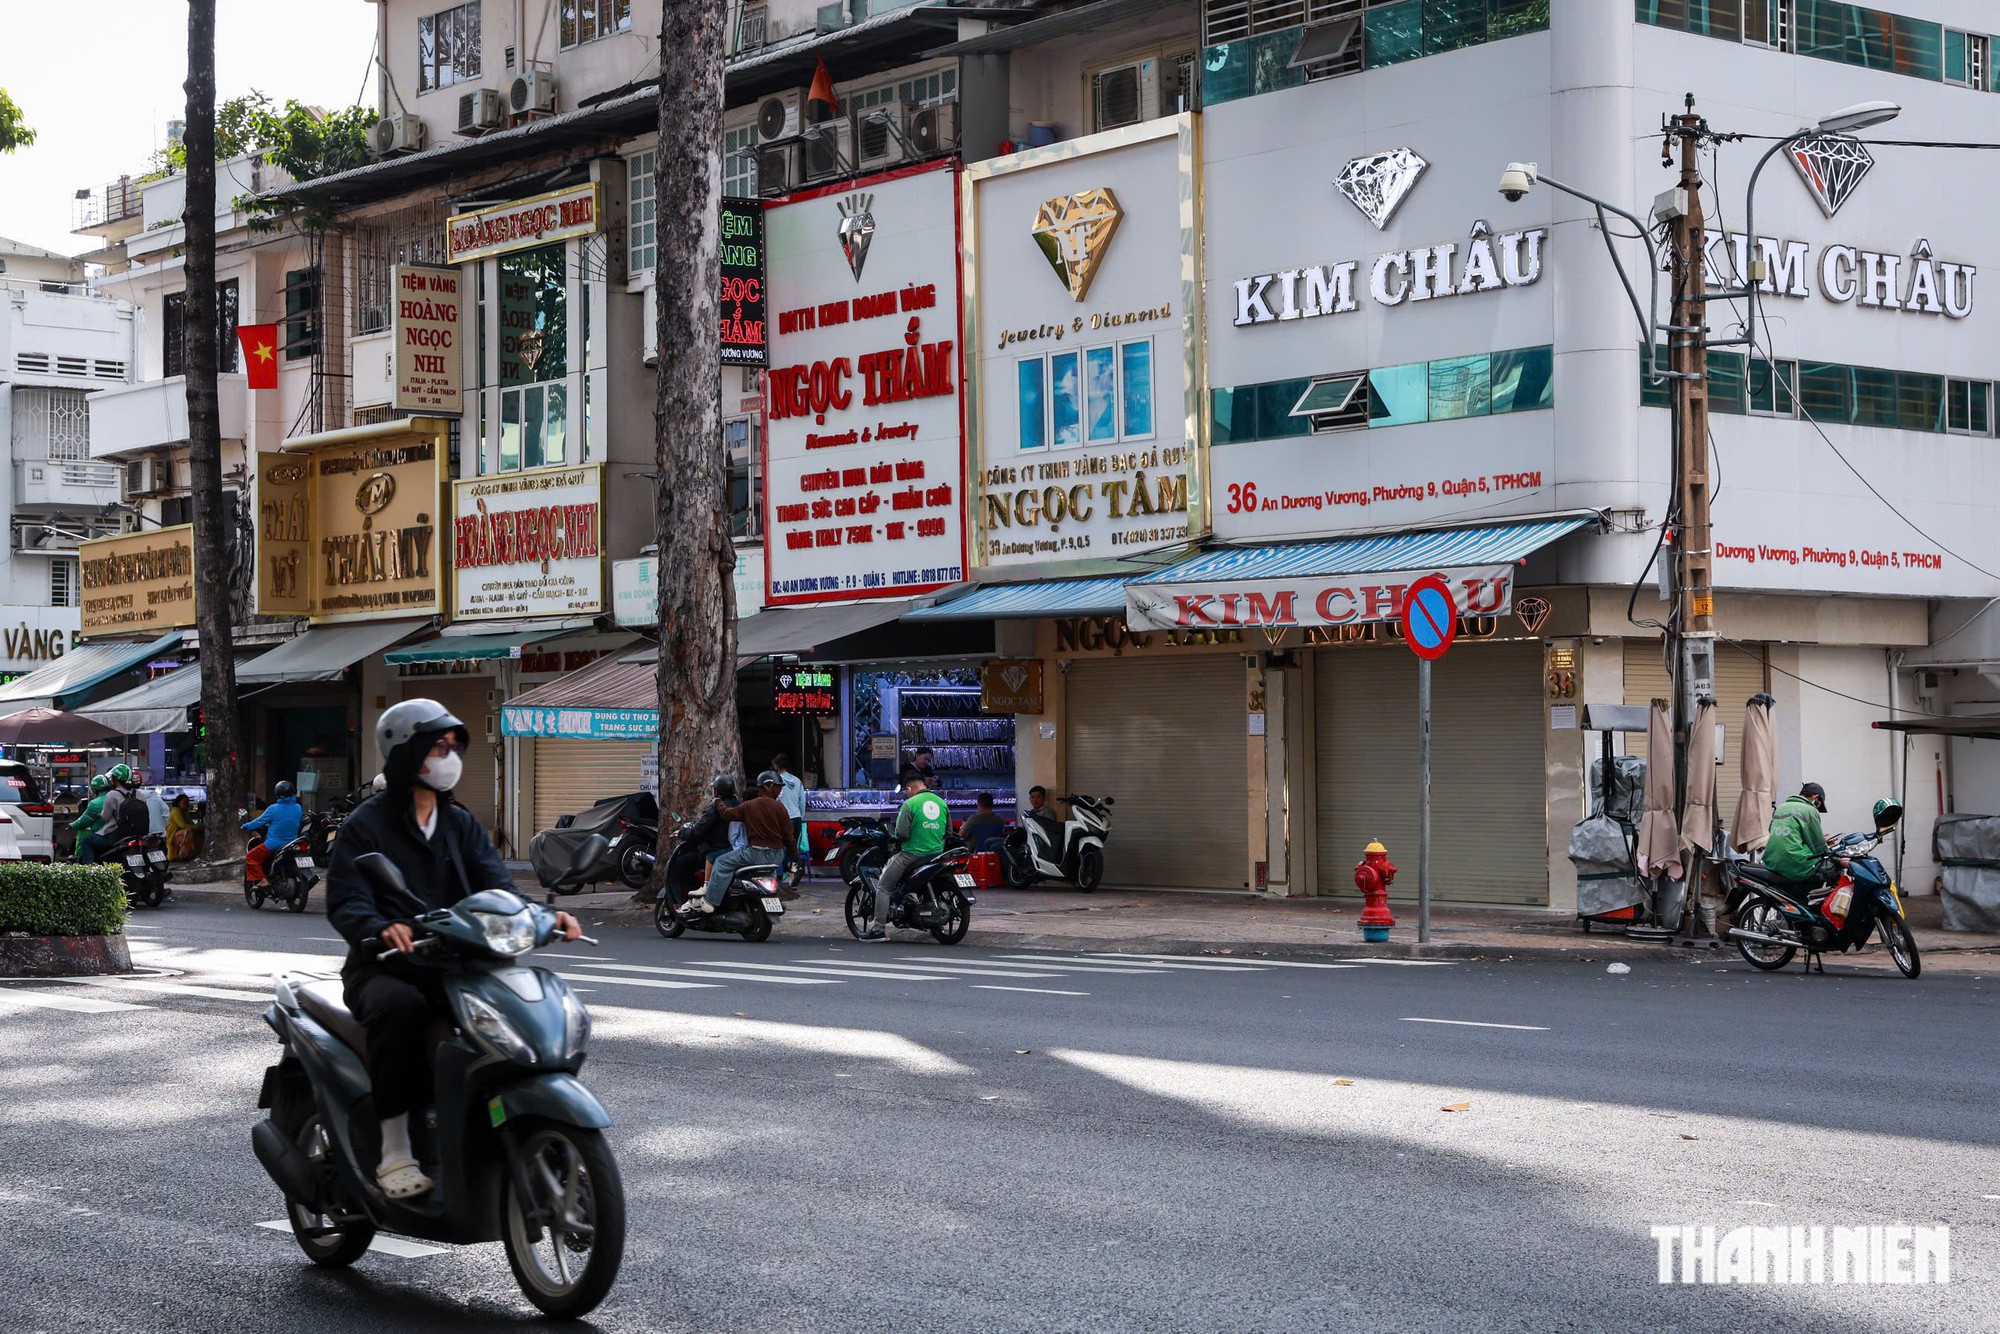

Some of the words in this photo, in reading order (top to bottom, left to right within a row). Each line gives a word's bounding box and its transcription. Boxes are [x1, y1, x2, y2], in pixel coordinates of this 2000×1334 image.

[450, 215, 507, 252] HOÀNG
[509, 204, 557, 239] NGỌC
[559, 197, 593, 228] NHI
[722, 211, 752, 238] ỆM
[721, 241, 756, 266] ÀNG
[401, 273, 426, 293] TIỆM
[430, 275, 456, 293] VÀNG
[1233, 260, 1359, 327] KIM
[1369, 219, 1548, 306] CHÂU
[1701, 227, 1809, 299] KIM
[1816, 238, 1977, 319] CHÂU
[721, 277, 760, 306] GỌC
[400, 298, 457, 322] HOÀNG
[779, 306, 815, 335] DNTN
[818, 300, 849, 327] KINH
[852, 291, 897, 321] DOANH
[900, 283, 936, 312] VÀNG
[406, 328, 452, 351] NGỌC
[998, 324, 1064, 350] Jewelry
[1071, 316, 1083, 333] &
[1091, 302, 1171, 330] Diamond
[414, 354, 445, 374] NHI
[410, 377, 426, 385] ITALIA
[431, 378, 449, 386] PLATIN
[768, 357, 852, 425] NGỌC
[805, 429, 858, 450] Diamonds
[861, 427, 872, 442] &
[874, 422, 919, 441] Jewelry
[842, 468, 867, 487] MUA
[870, 461, 893, 484] BÁN
[895, 458, 925, 481] VÀNG
[987, 464, 1016, 486] CÔNG
[1020, 464, 1034, 481] TY
[1039, 460, 1069, 480] TNHH
[1074, 454, 1107, 475] VÀNG
[1111, 453, 1136, 474] BẠC
[1140, 445, 1158, 468] ĐÁ
[986, 483, 1093, 532] NGỌC
[1101, 471, 1187, 518] TÂM
[1227, 482, 1258, 514] 36
[1261, 497, 1278, 511] An
[1281, 494, 1322, 511] Dương
[1325, 490, 1371, 506] Vương,
[1373, 485, 1424, 501] Phường
[1427, 481, 1438, 499] 9,
[1441, 479, 1477, 498] Quận
[1478, 477, 1490, 495] 5,
[1492, 471, 1541, 491] TPHCM
[776, 503, 809, 522] TRANG
[834, 497, 856, 517] CAO
[454, 498, 515, 568] HOÀNG
[514, 505, 564, 574] NGỌC
[563, 502, 598, 559] NHI
[786, 529, 813, 550] VÀNG
[815, 527, 843, 547] ITALY
[917, 517, 946, 537] 9999
[322, 516, 387, 585] THÁI
[1715, 542, 1755, 563] Dương
[1758, 545, 1799, 565] Vương,
[1802, 547, 1846, 568] Phường
[1849, 552, 1859, 567] 9,
[1861, 551, 1889, 570] Quận
[1891, 552, 1900, 569] 5,
[1903, 553, 1942, 569] TPHCM
[790, 580, 798, 592] AN
[800, 577, 818, 591] DƯƠNG
[819, 576, 838, 590] VƯƠNG
[852, 575, 856, 588] 9
[881, 573, 885, 586] 5
[1174, 589, 1299, 628] KIM
[1315, 572, 1511, 624] CHU
[1701, 603, 1709, 611] 12
[4, 621, 64, 660] VÀNG
[1548, 672, 1575, 699] 36
[558, 710, 592, 733] SINH
[600, 723, 626, 731] TRANG
[923, 821, 940, 829] Grab
